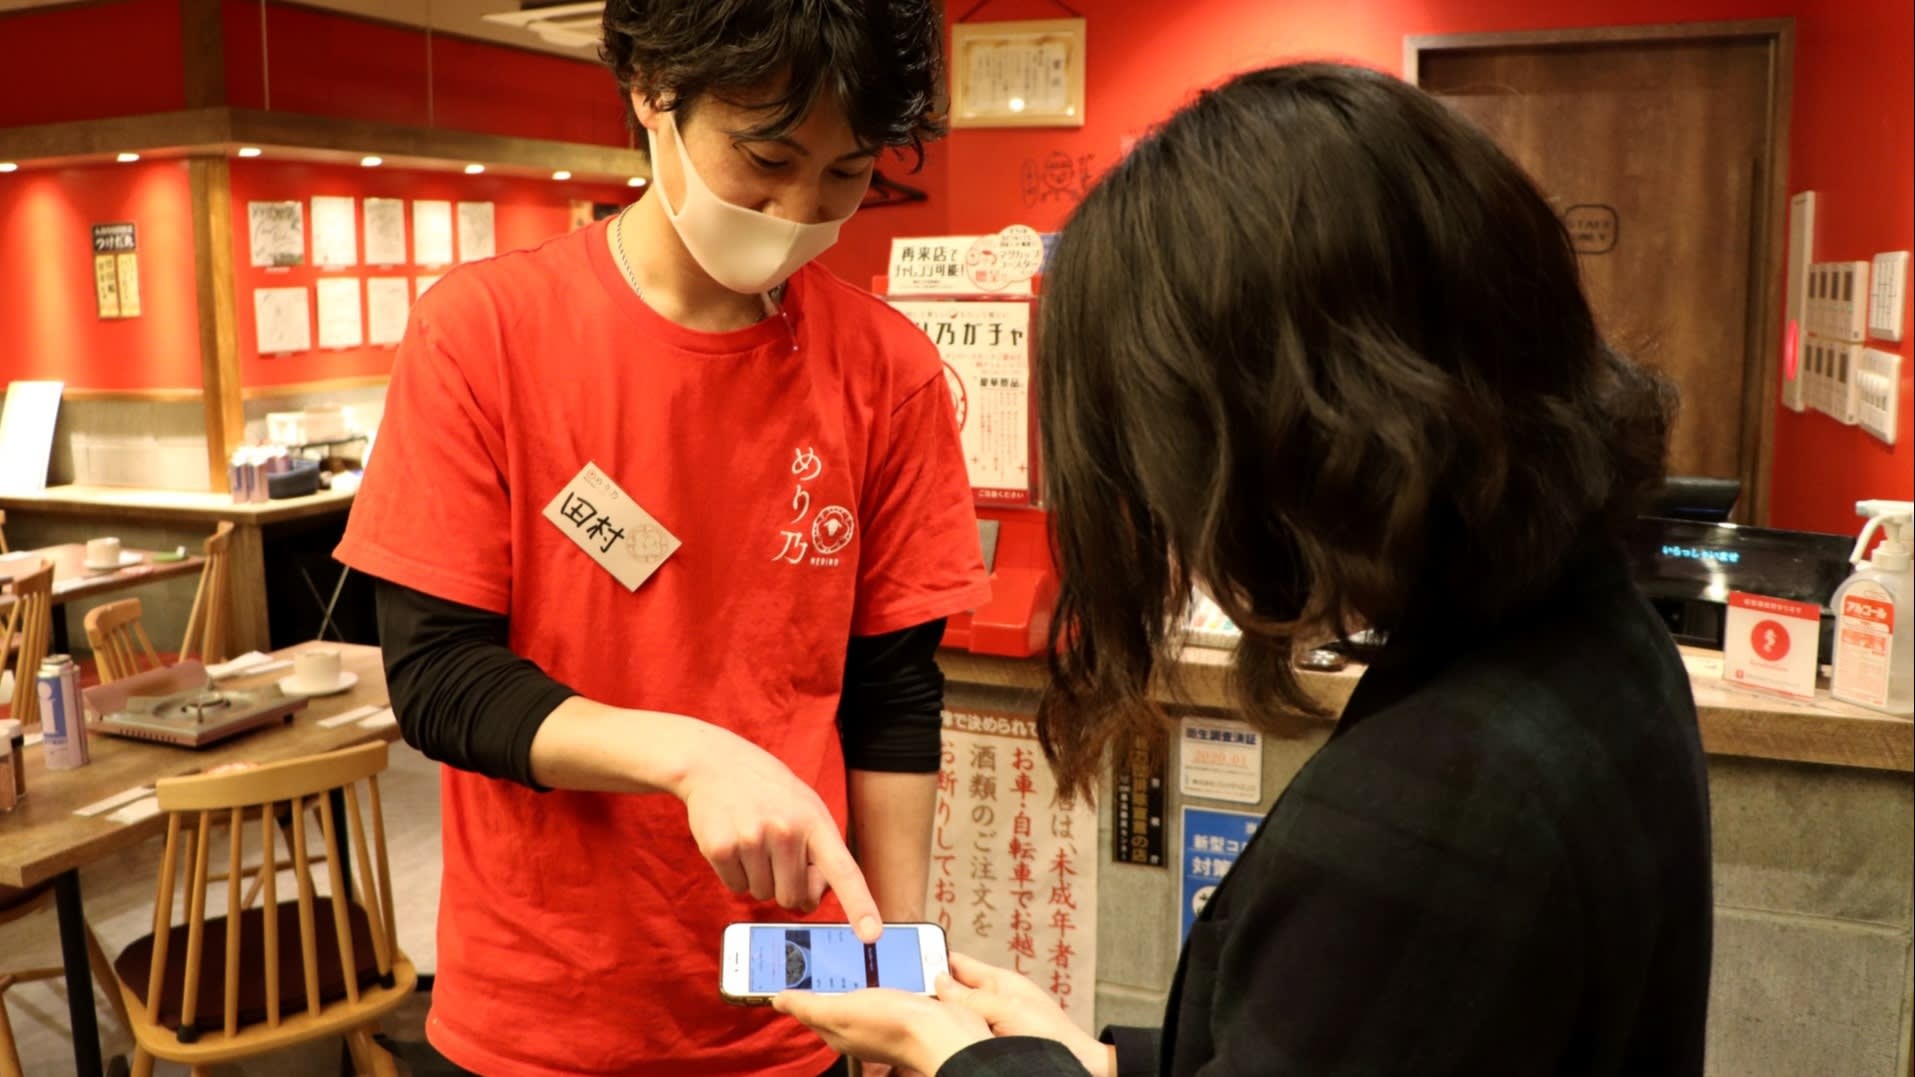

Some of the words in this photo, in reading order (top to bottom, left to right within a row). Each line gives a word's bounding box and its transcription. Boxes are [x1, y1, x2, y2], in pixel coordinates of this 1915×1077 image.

[560, 491, 625, 554] 田村
[771, 446, 822, 565] めり乃
[968, 743, 997, 938] 酒類のご注文を
